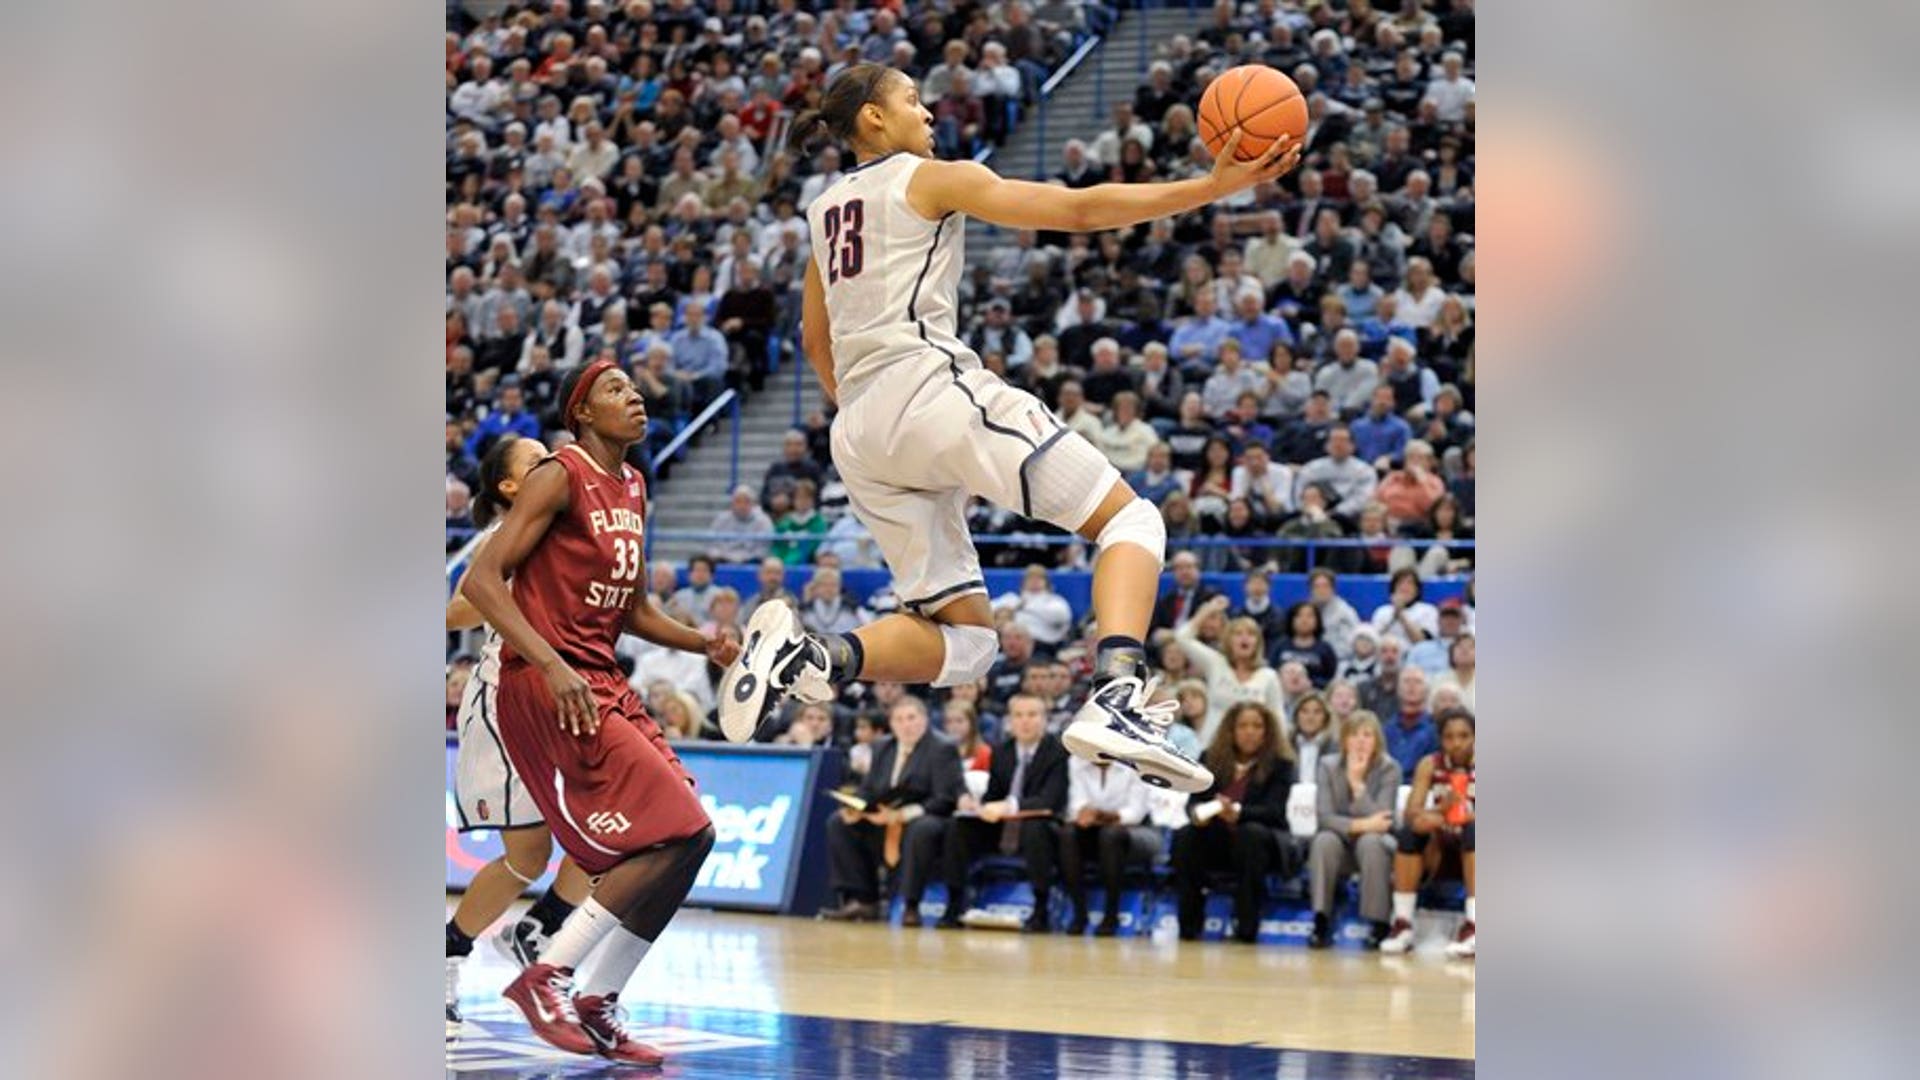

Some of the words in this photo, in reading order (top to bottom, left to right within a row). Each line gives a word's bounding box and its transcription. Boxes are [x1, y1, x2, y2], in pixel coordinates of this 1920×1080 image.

[824, 198, 864, 287] 23
[611, 537, 640, 581] 33
[585, 581, 634, 610] STAT
[586, 811, 632, 834] FSU
